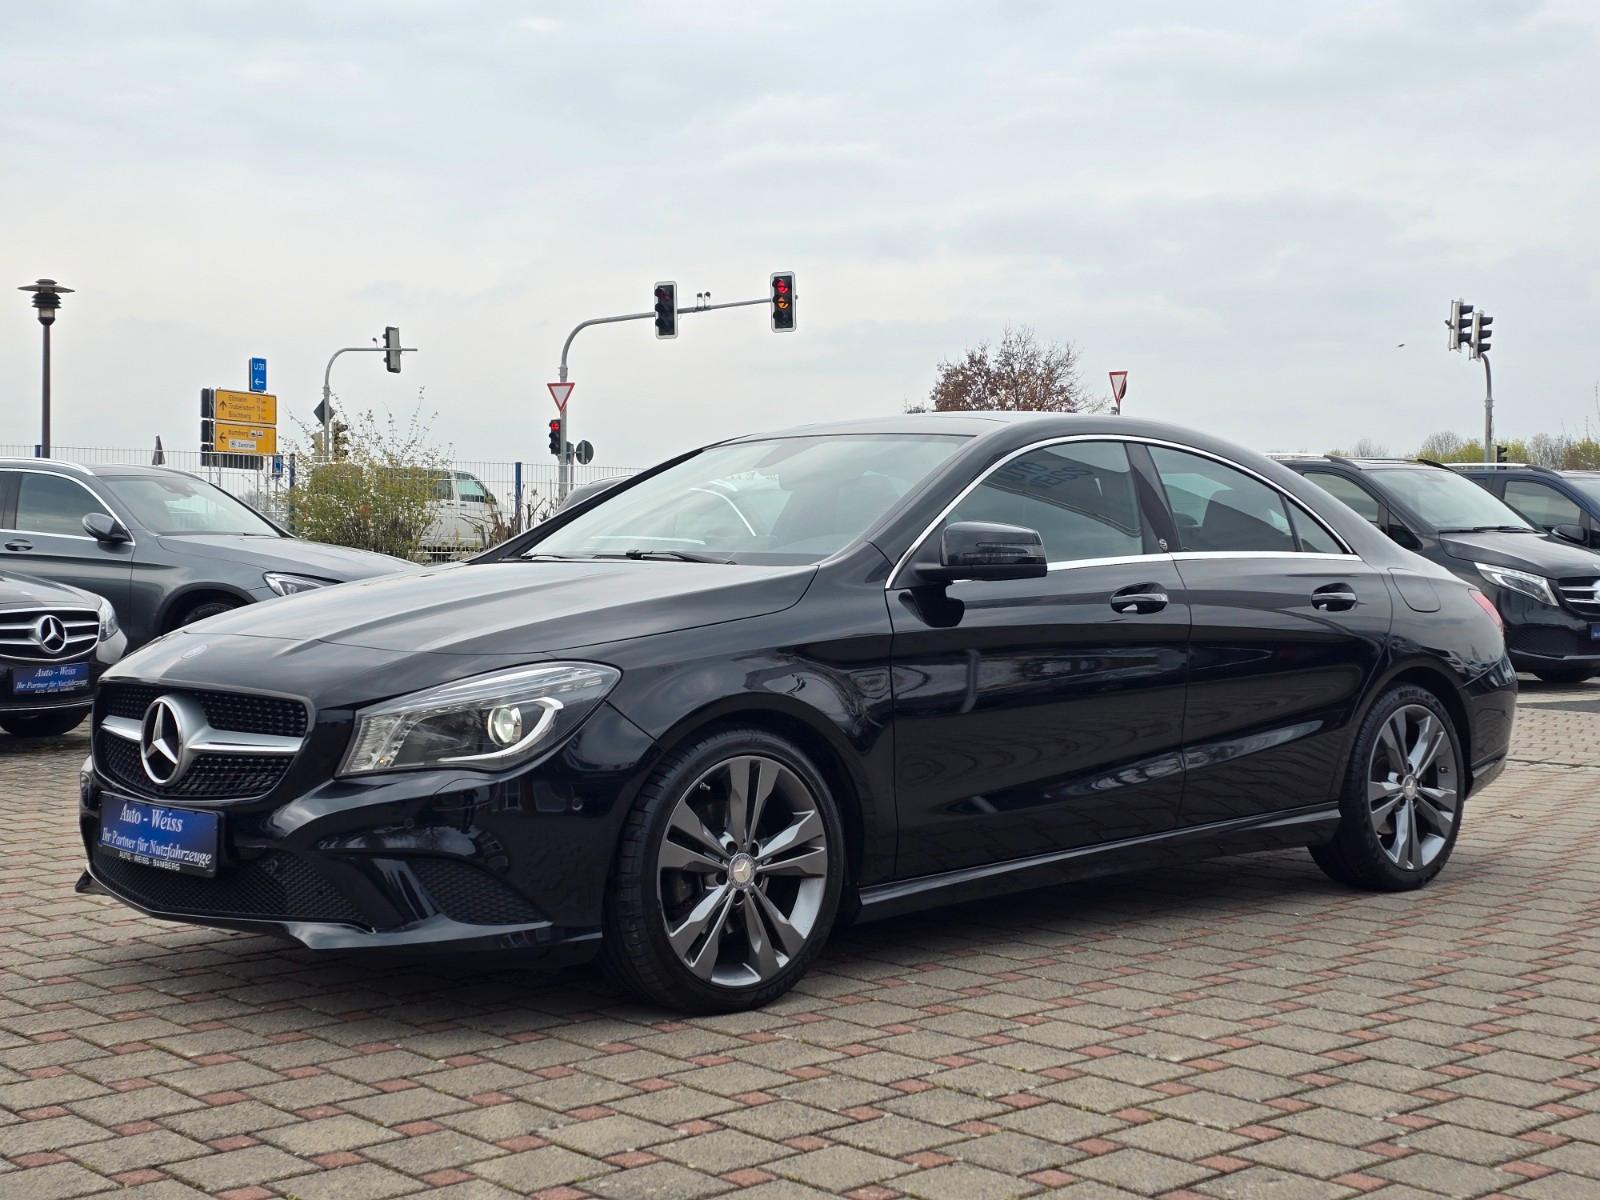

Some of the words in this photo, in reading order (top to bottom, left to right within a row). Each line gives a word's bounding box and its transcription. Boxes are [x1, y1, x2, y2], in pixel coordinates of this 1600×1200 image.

[35, 668, 53, 677] Auto
[59, 666, 77, 676] Weiss
[16, 681, 26, 689] Ihr
[26, 681, 48, 689] Partner
[120, 803, 142, 825] Auto
[151, 808, 184, 833] Weiss
[102, 827, 112, 842] Ihr
[112, 830, 136, 849] Partner
[135, 837, 149, 854] für
[149, 840, 213, 868] Nutzfahrzeuge
[133, 854, 150, 866] WEISS
[152, 858, 181, 872] BAMBERG
